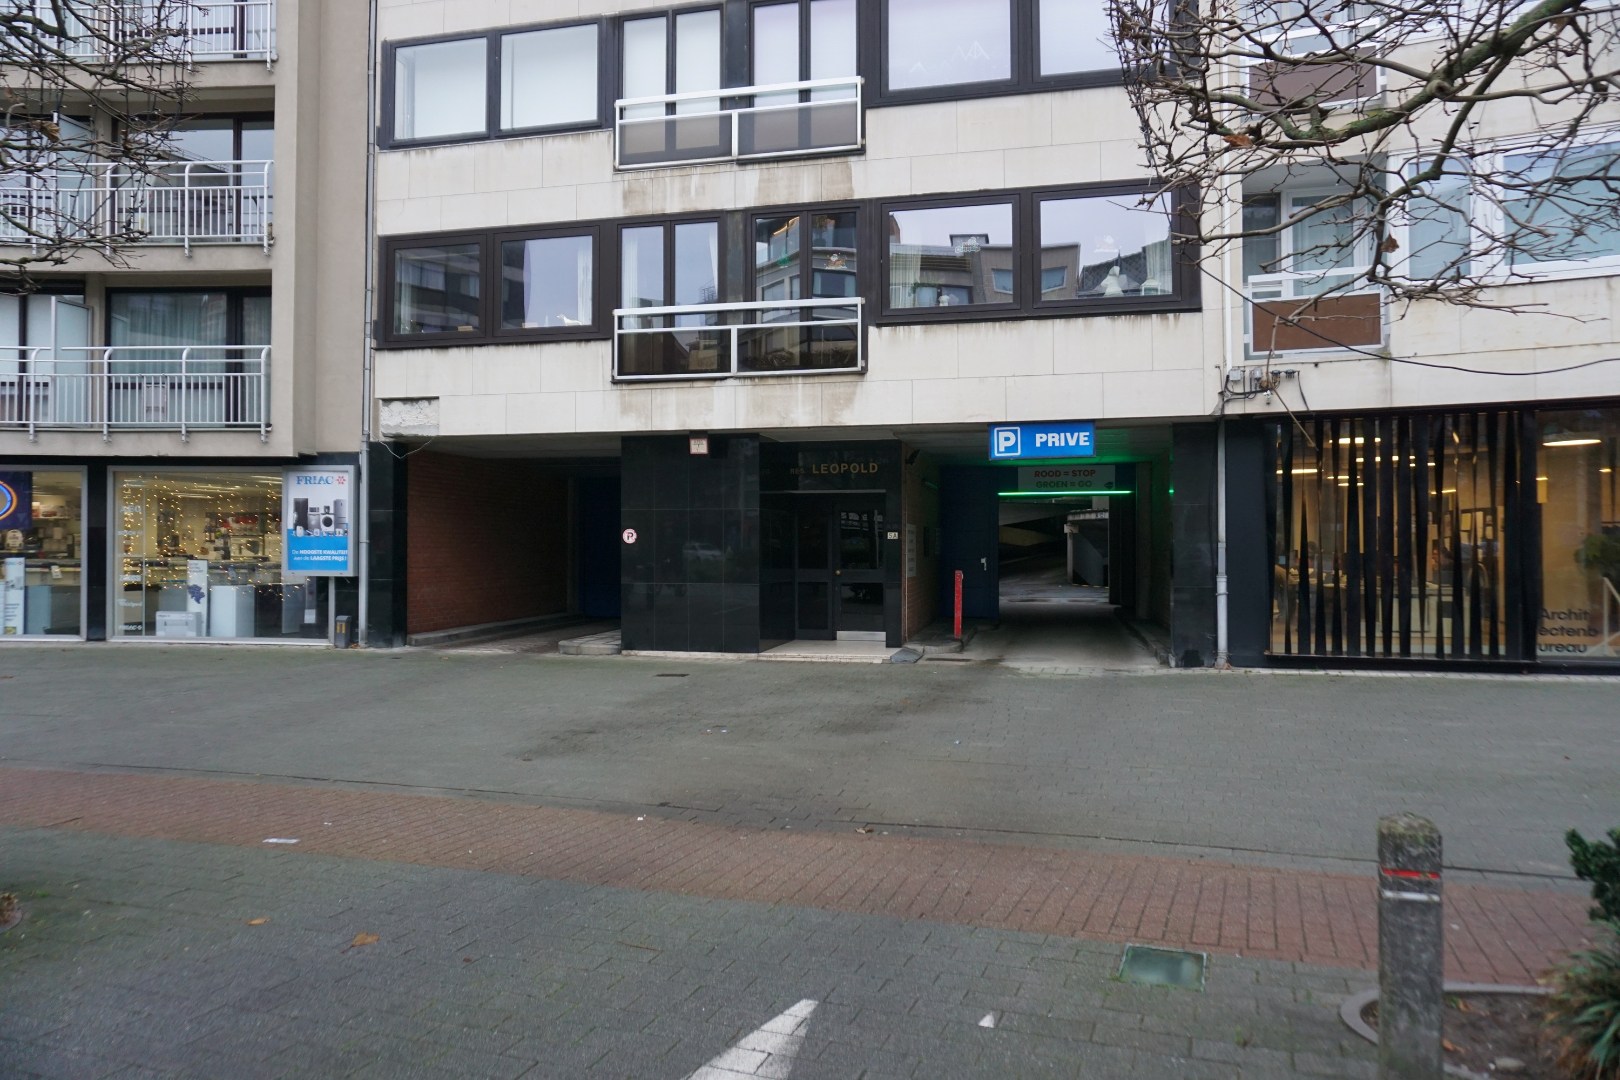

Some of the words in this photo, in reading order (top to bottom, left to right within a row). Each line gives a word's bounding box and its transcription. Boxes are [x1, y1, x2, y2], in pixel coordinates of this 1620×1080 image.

[1035, 432, 1090, 447] PRIVE
[812, 463, 878, 474] LEOPOLD
[1034, 470, 1062, 478] ROOD
[1071, 469, 1096, 478] STOP
[296, 475, 334, 485] FRIAC
[1035, 480, 1068, 489] GROEN
[1077, 480, 1093, 489] GO
[1539, 643, 1588, 653] ureau
